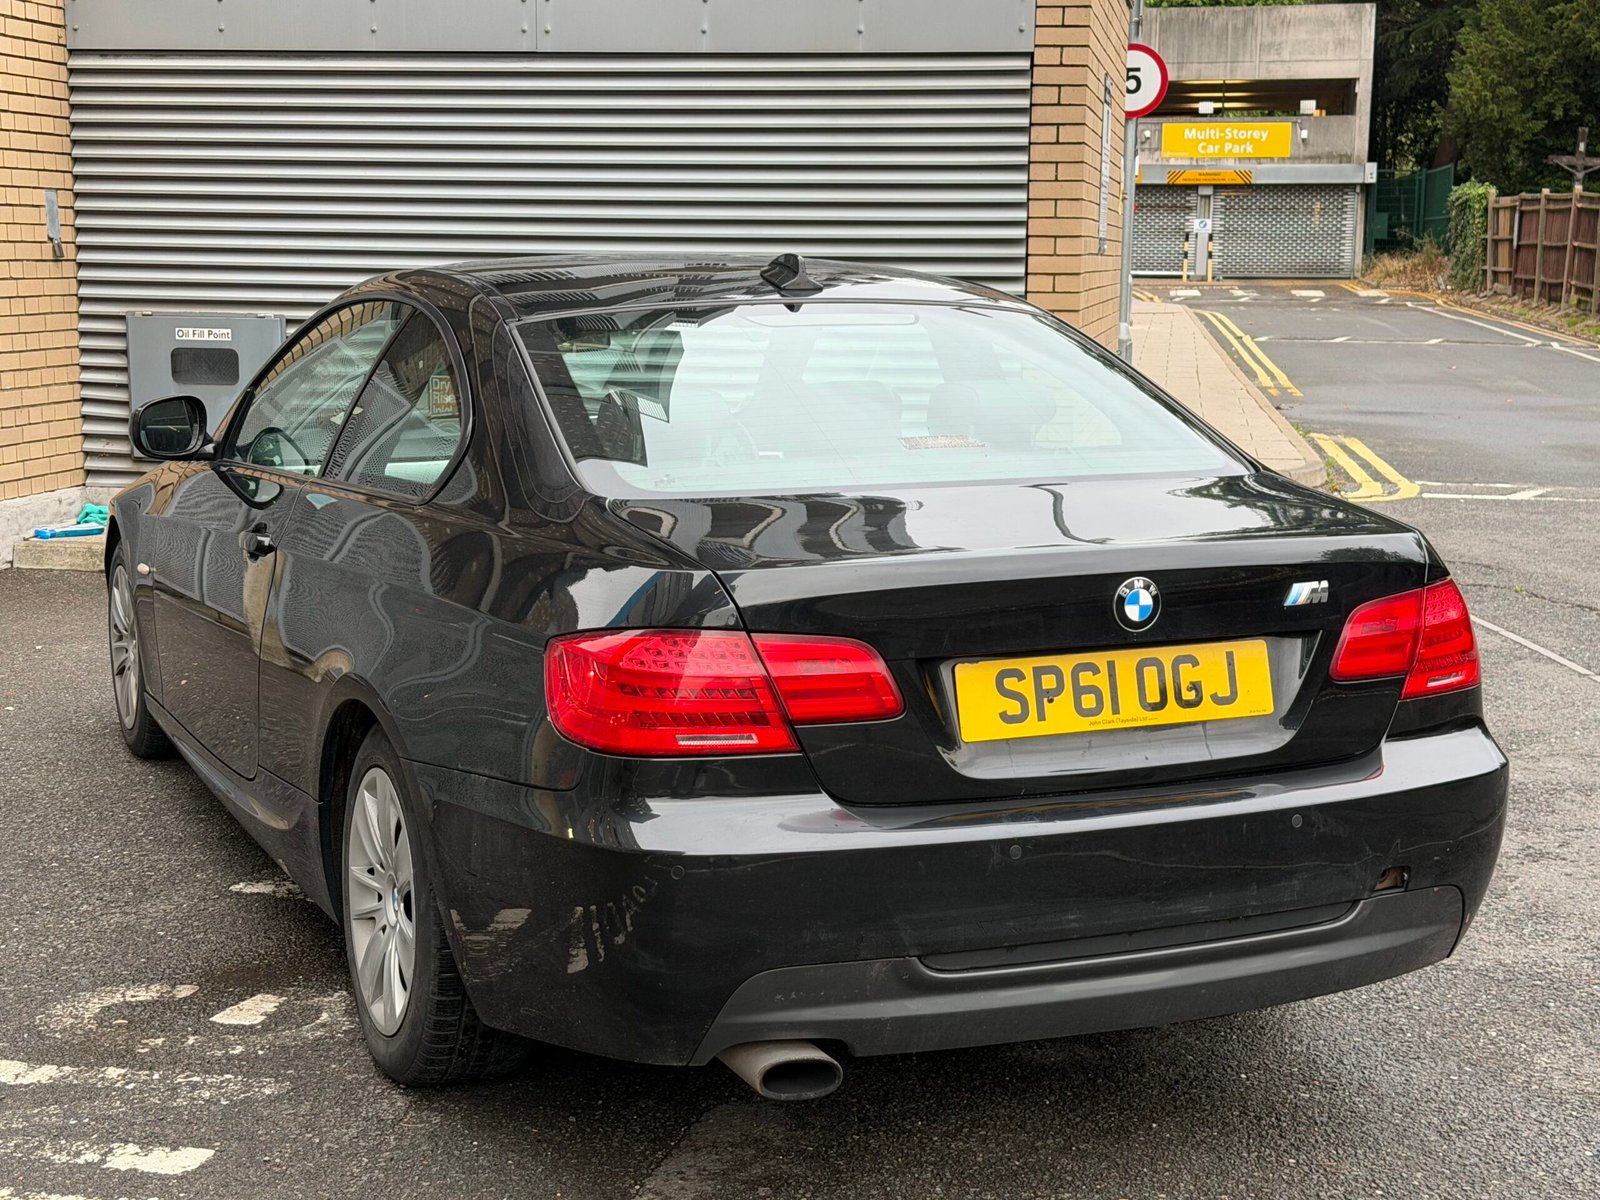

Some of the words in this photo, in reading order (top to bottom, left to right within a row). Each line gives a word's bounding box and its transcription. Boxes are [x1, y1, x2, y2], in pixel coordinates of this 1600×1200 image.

[1126, 67, 1142, 95] 5
[1183, 127, 1269, 142] Multi-Storey
[1197, 142, 1220, 154] Car
[1224, 142, 1254, 154] Park
[177, 329, 189, 338] Oil
[192, 329, 205, 338] Fill
[207, 329, 230, 339] Point
[432, 378, 451, 393] Dry
[1119, 579, 1158, 598] BMW
[994, 659, 1120, 725] SP61
[1135, 650, 1239, 712] OGJ
